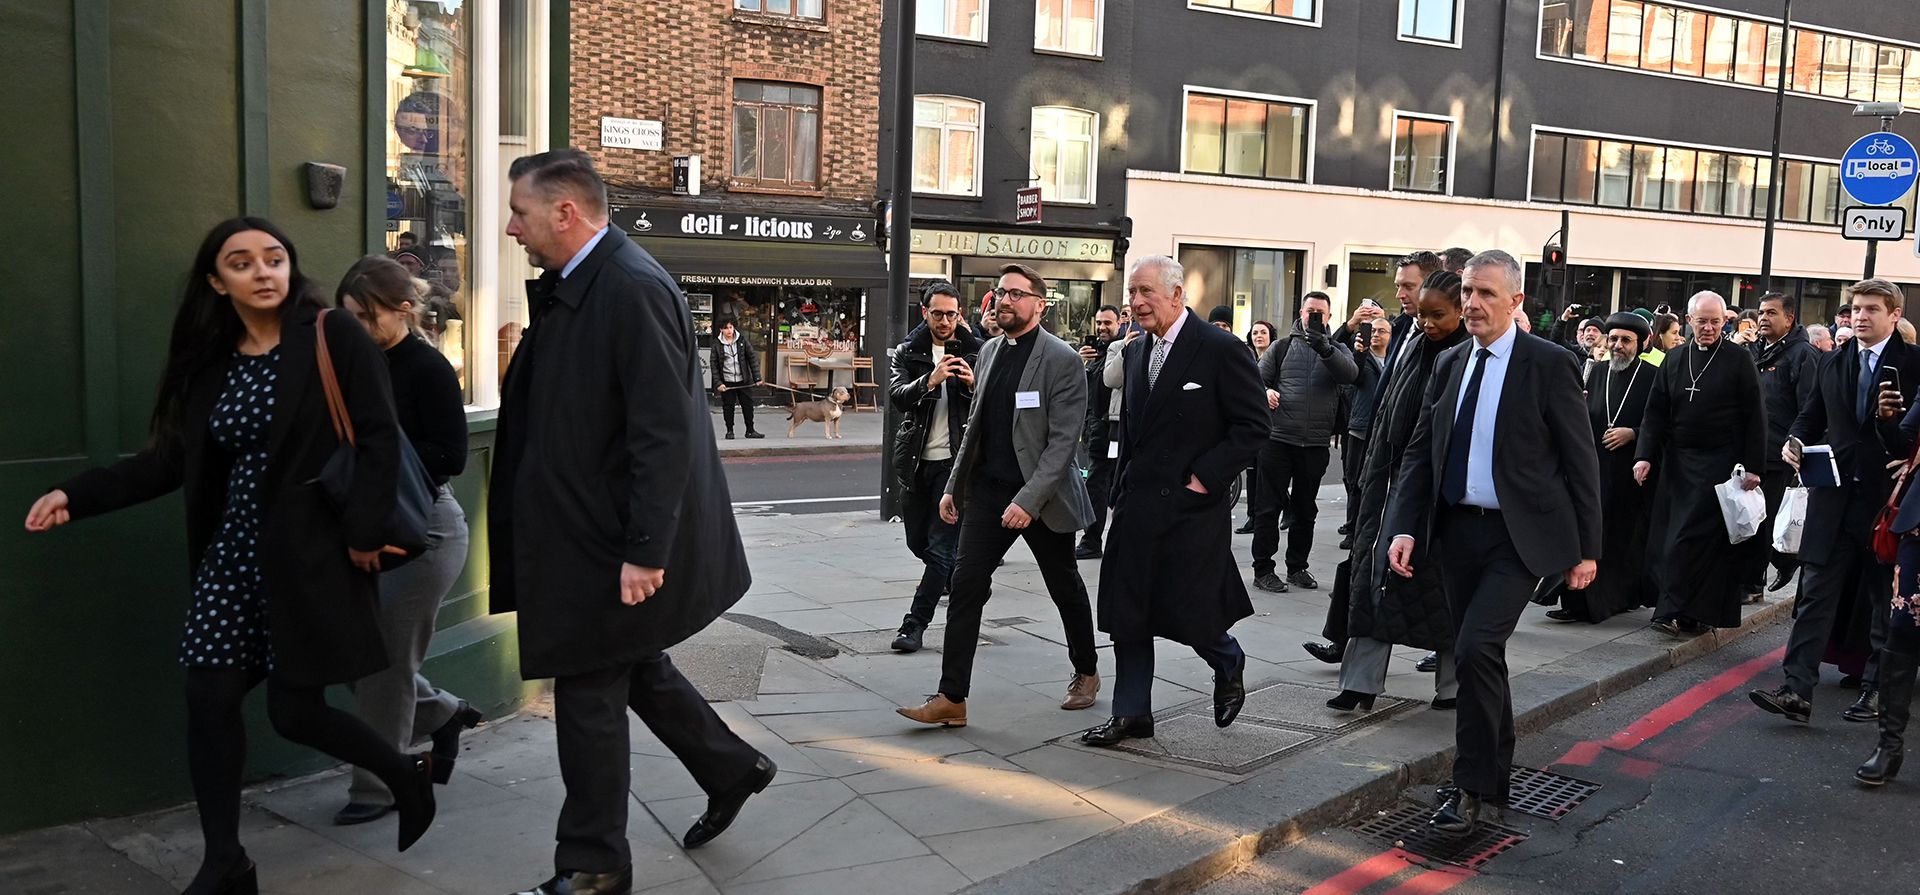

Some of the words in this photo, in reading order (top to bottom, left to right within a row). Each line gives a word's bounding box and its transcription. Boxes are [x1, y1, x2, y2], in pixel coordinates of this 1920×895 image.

[604, 126, 630, 134] KINGS
[632, 127, 660, 137] CROSS
[604, 136, 630, 144] ROAD
[1868, 161, 1898, 170] local
[1020, 193, 1038, 205] BARBER
[1019, 207, 1033, 218] SHOP
[680, 213, 723, 235] deli
[744, 216, 813, 239] licious
[822, 225, 842, 239] 2go
[936, 233, 974, 251] THE
[987, 236, 1068, 255] SALOON
[681, 275, 716, 284] FRESHLY
[717, 276, 740, 284] MADE
[741, 277, 782, 285] SANDWICH
[783, 277, 789, 285] &
